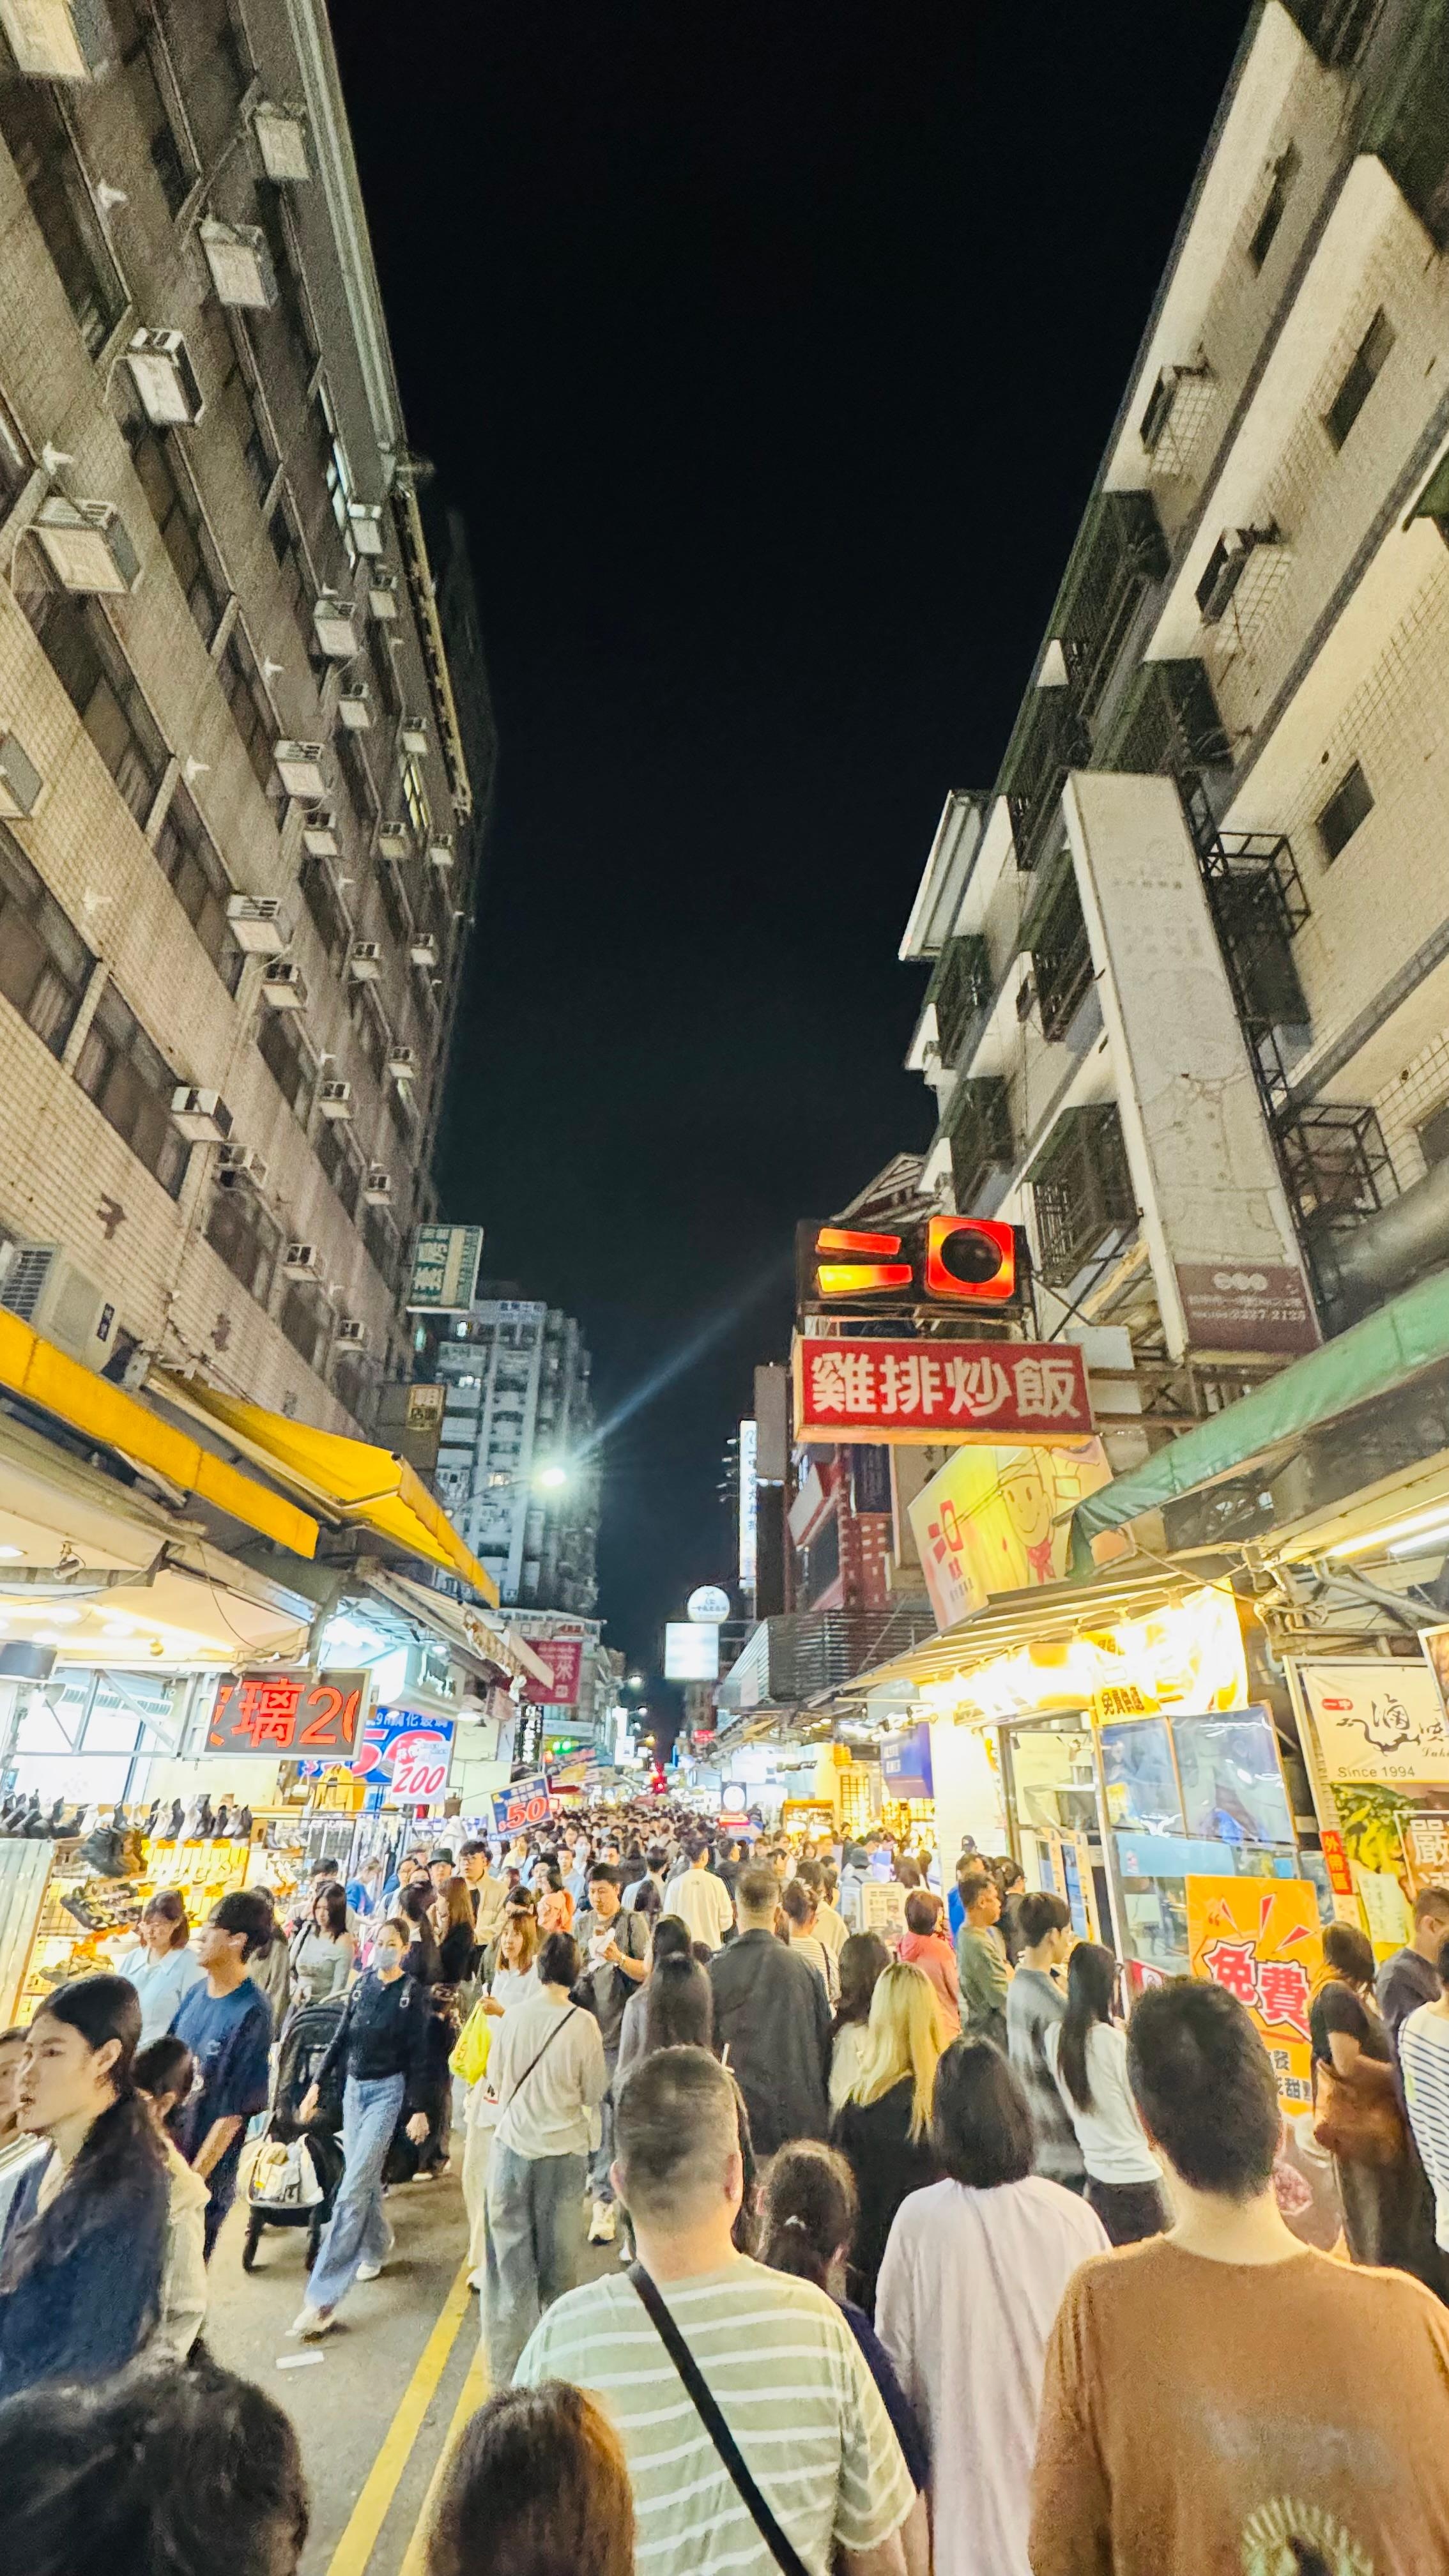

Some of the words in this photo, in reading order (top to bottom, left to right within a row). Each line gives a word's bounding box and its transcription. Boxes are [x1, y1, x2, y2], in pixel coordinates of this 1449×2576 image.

[811, 1351, 1080, 1418] 雞排炒飯
[1323, 1699, 1351, 1710] 一中
[392, 1765, 447, 1795] 200
[1338, 1767, 1377, 1778] Since
[1382, 1766, 1416, 1777] 1994
[1324, 1835, 1350, 1890] 外帶區
[1204, 1942, 1313, 2041] 免費
